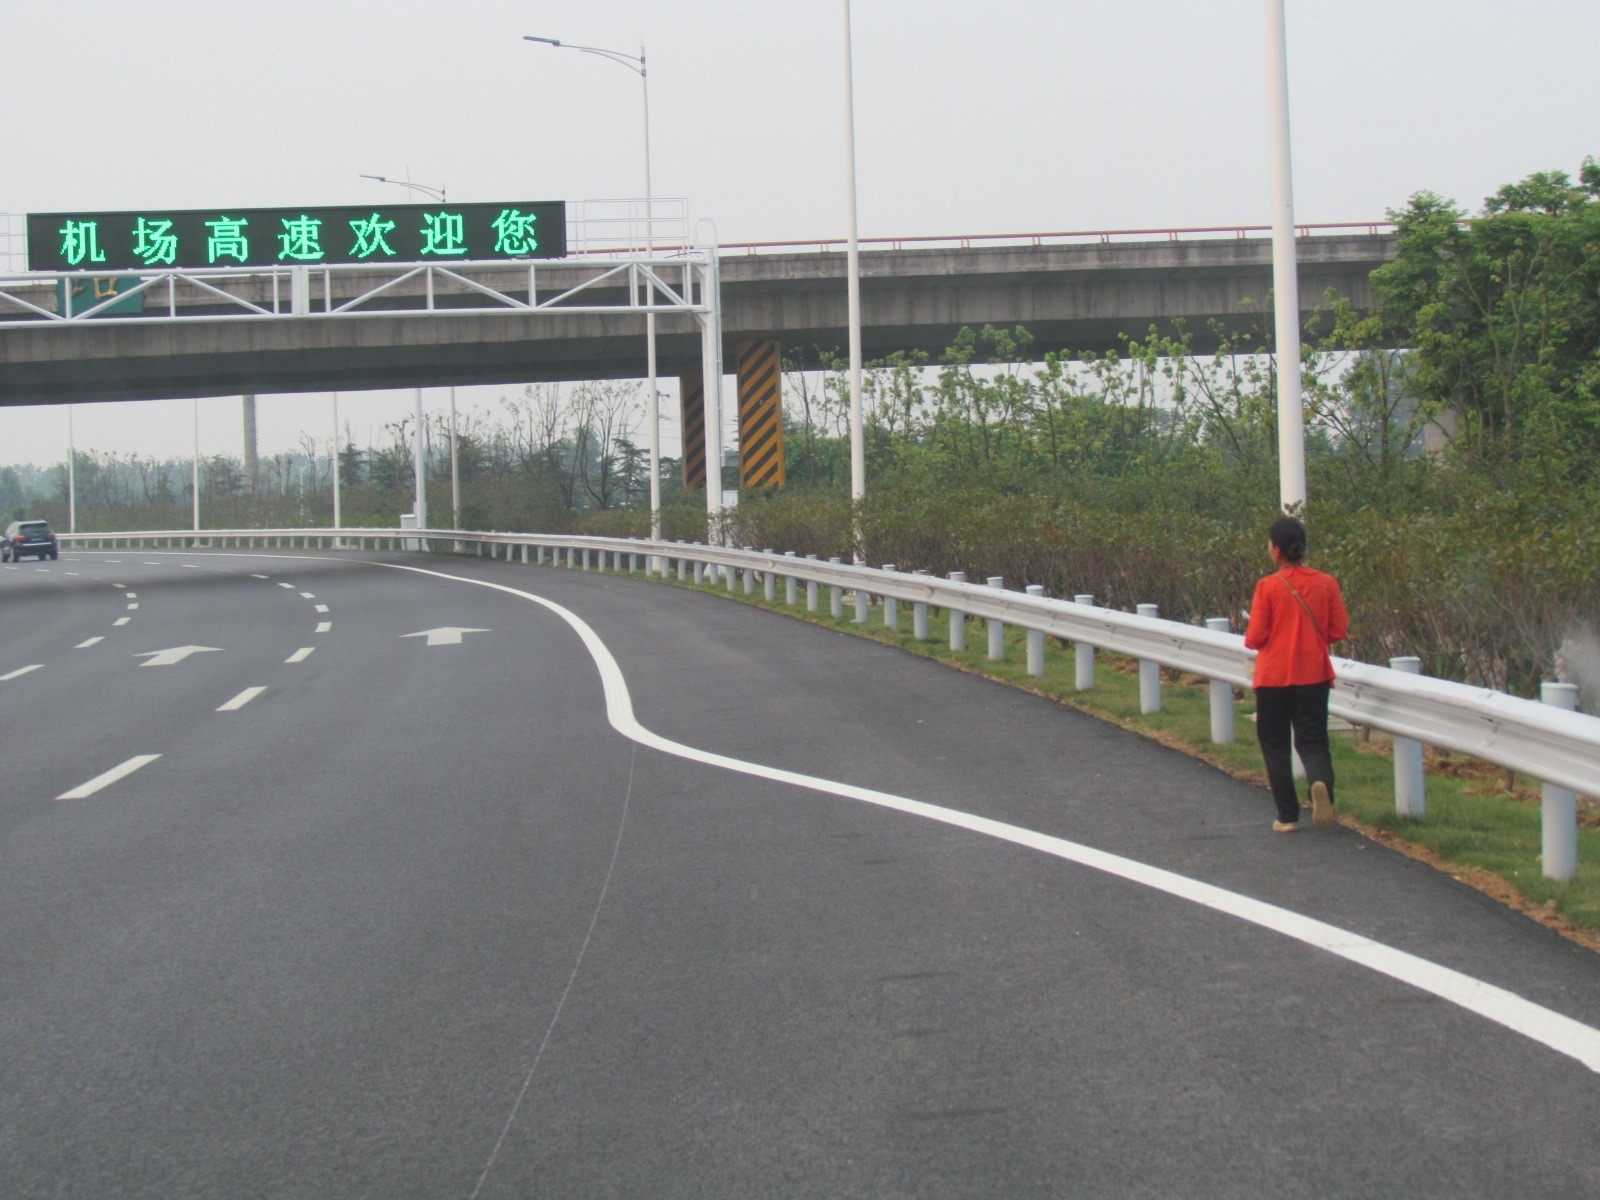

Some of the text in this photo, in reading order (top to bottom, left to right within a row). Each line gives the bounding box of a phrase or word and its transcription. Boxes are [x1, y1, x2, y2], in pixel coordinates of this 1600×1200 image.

[59, 209, 538, 265] 机场高速欢迎您
